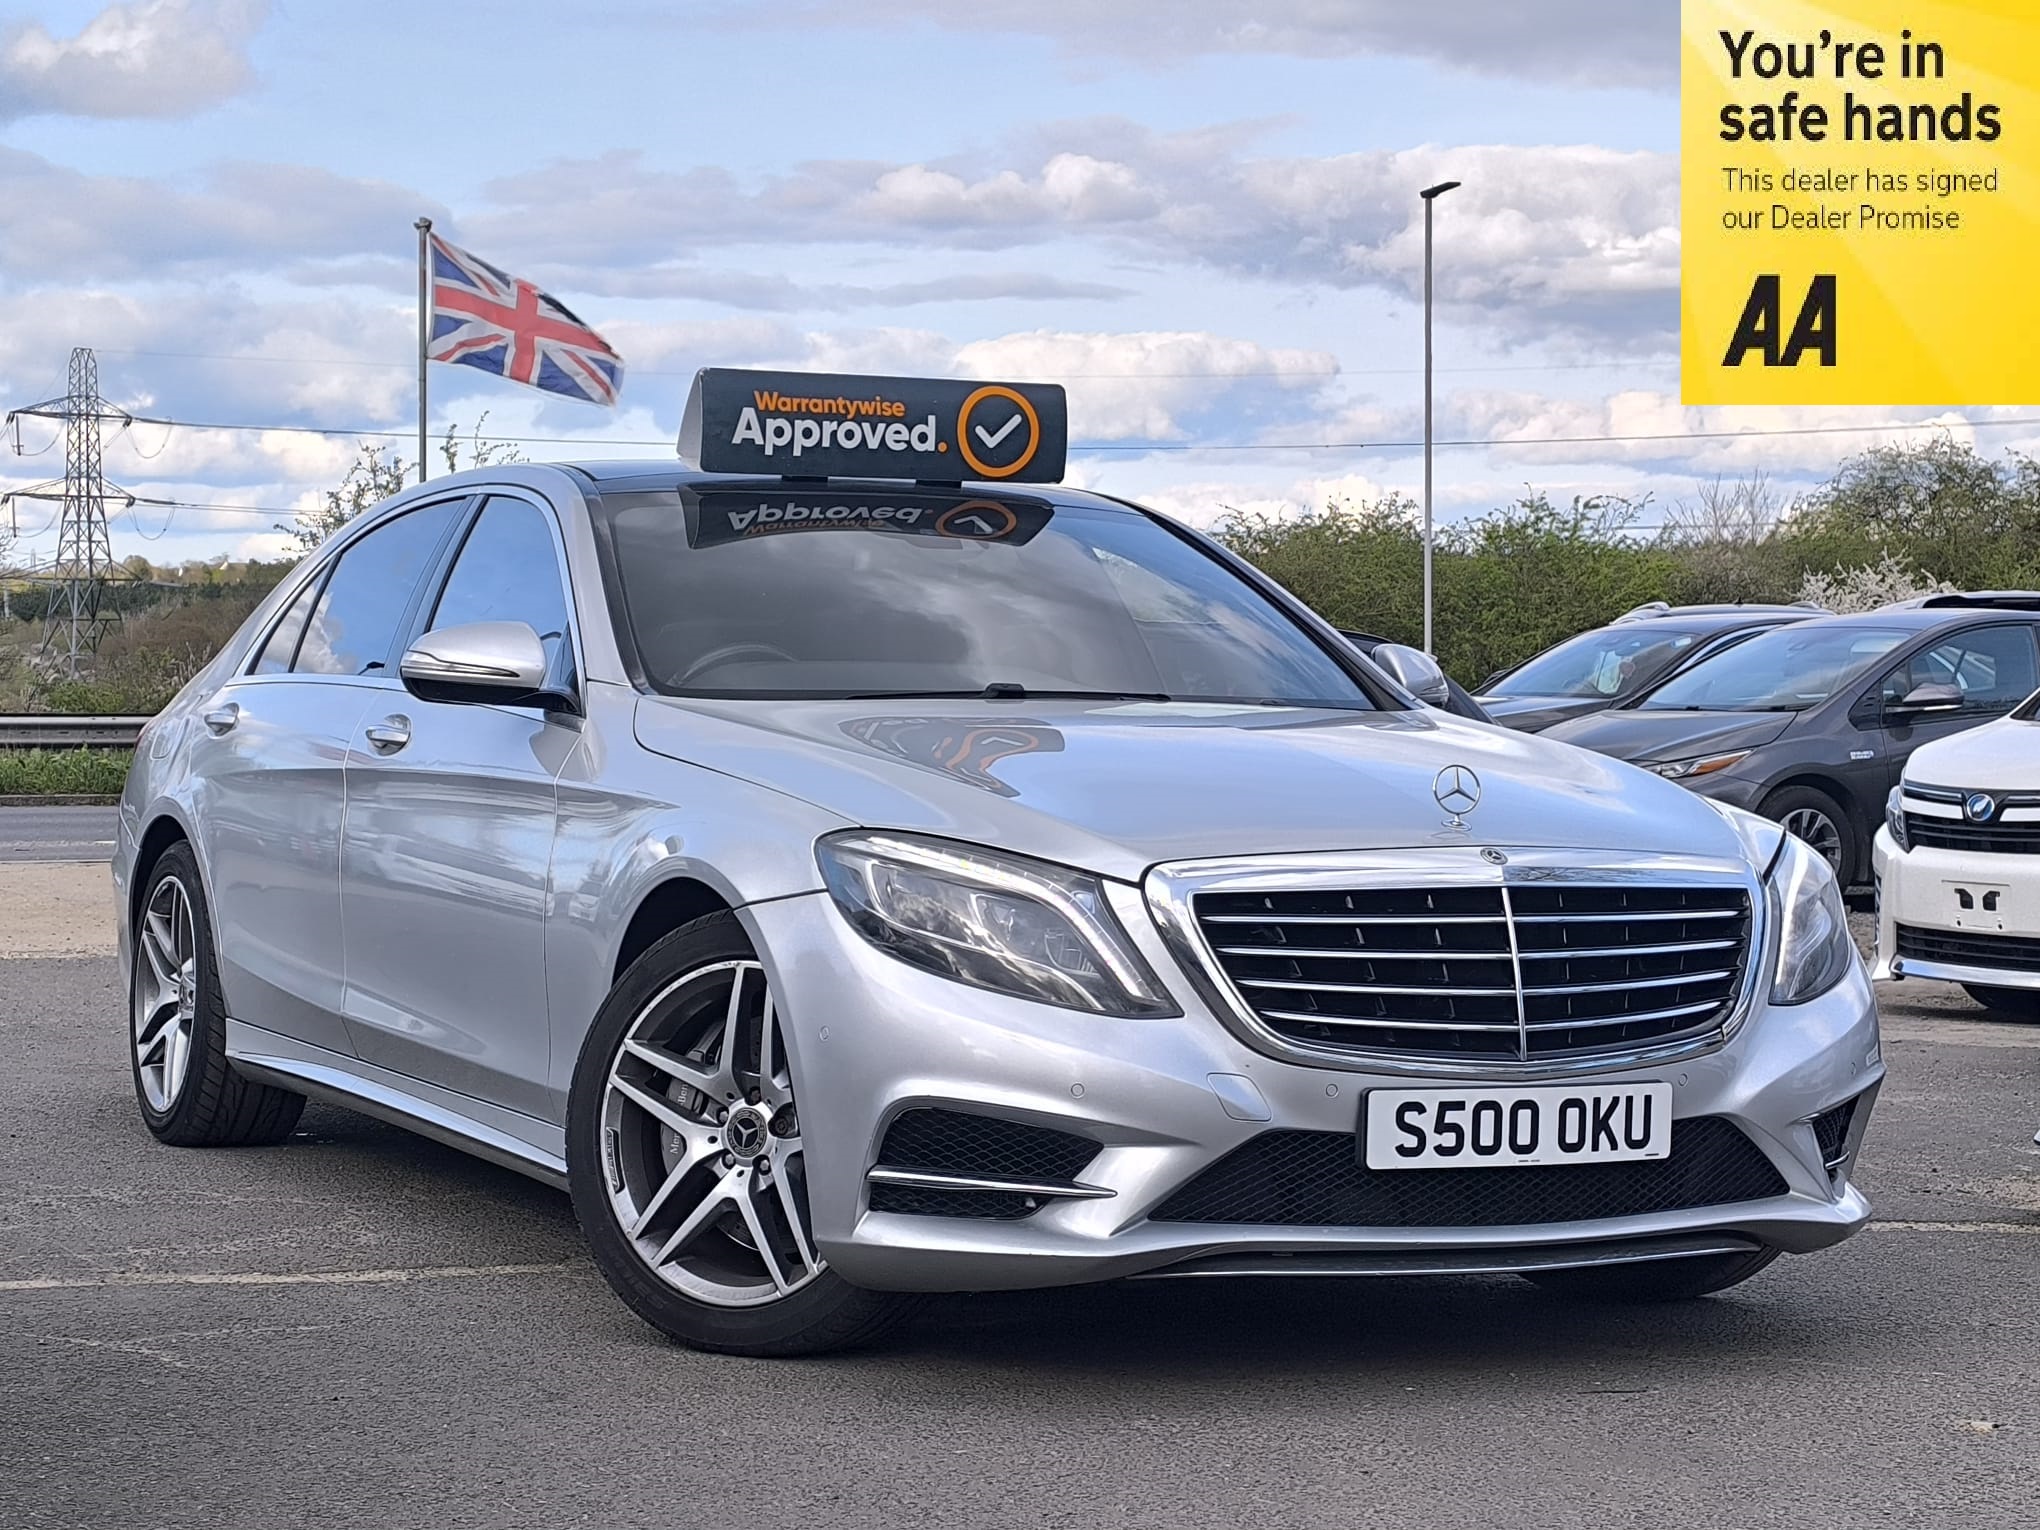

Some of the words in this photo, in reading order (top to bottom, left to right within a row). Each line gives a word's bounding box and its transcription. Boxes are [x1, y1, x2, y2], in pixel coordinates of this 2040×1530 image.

[754, 390, 906, 419] Warrantywise
[731, 407, 948, 456] Approved.
[1394, 1098, 1540, 1158] S500
[1557, 1094, 1653, 1153] OKU
